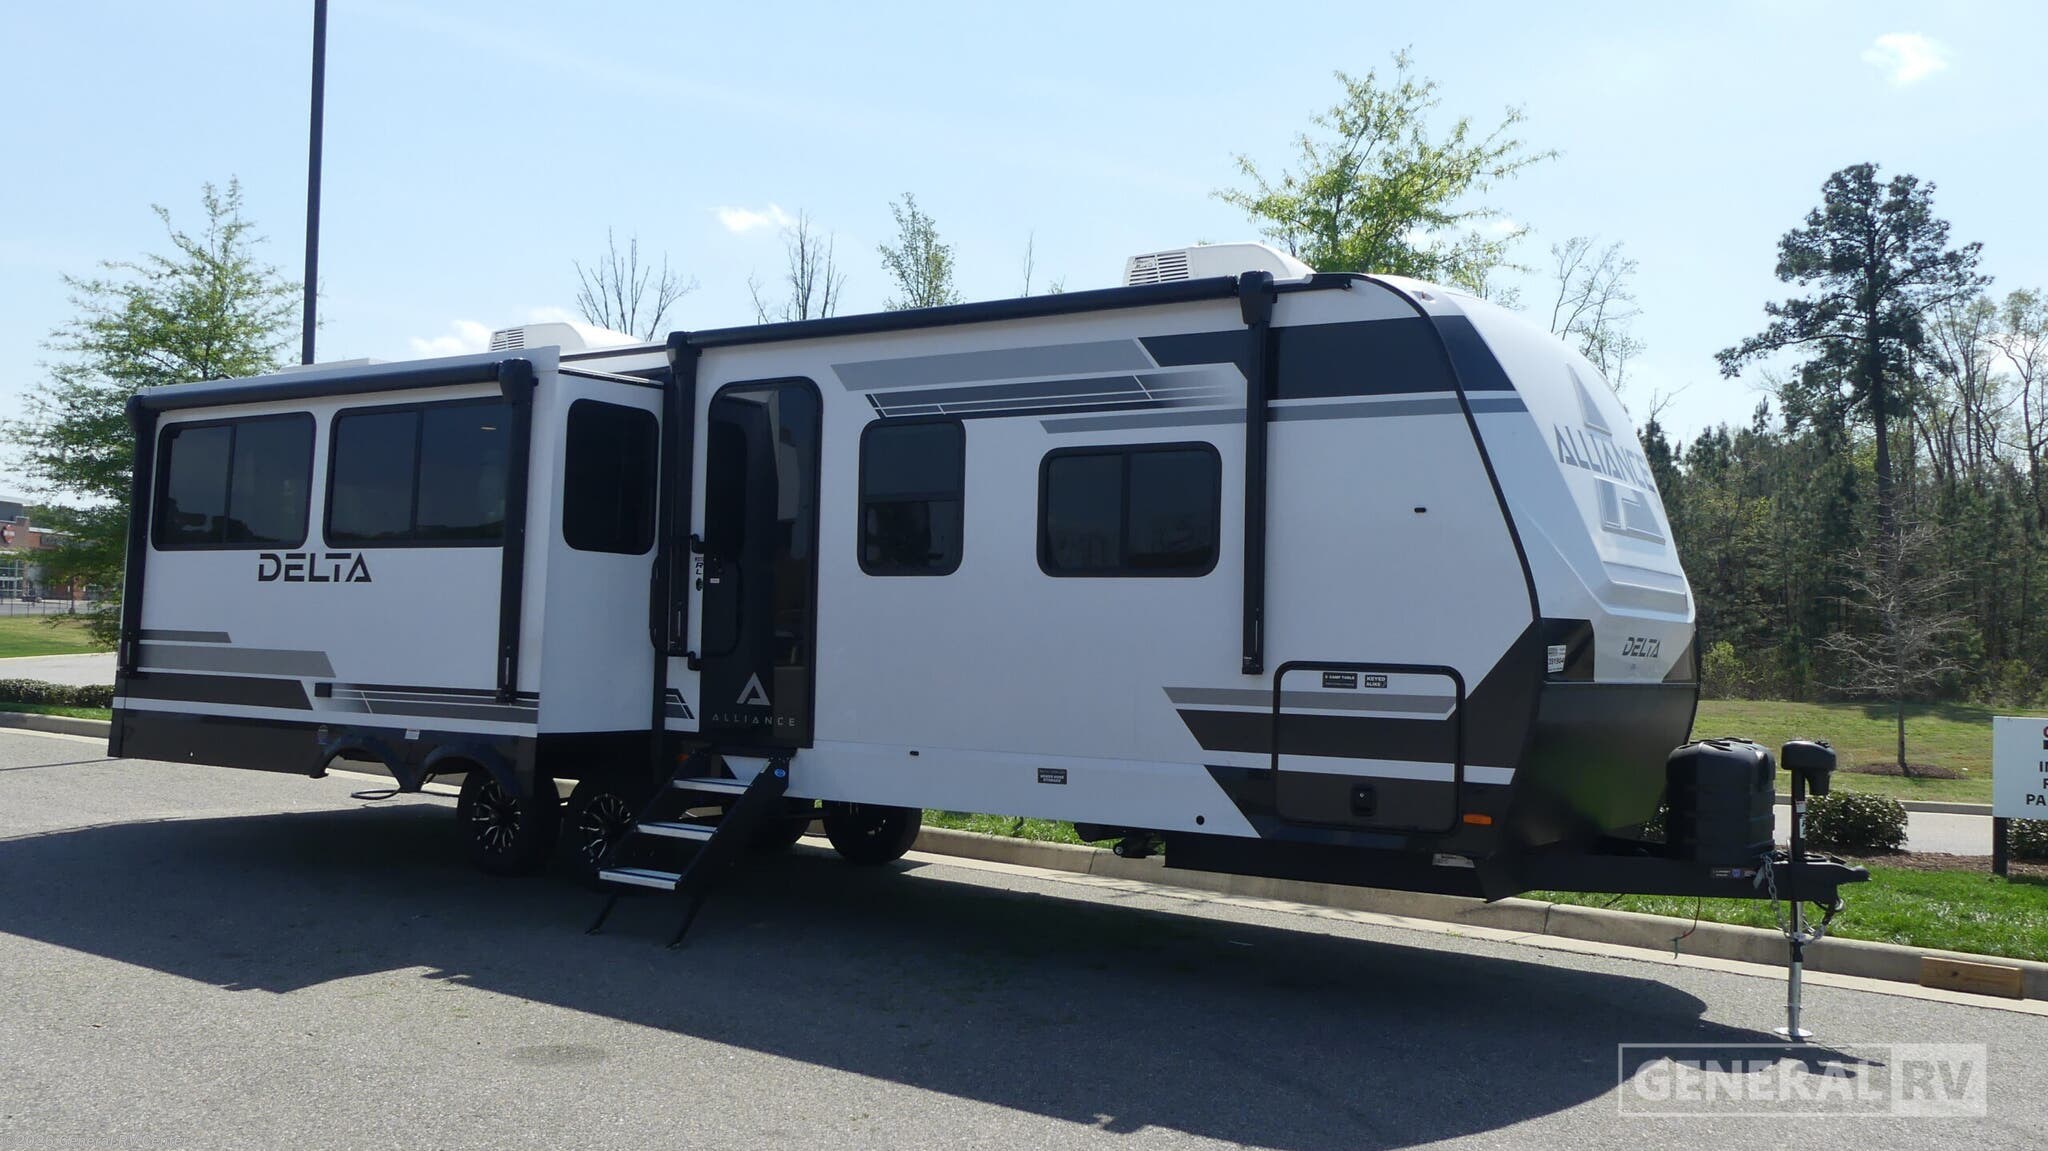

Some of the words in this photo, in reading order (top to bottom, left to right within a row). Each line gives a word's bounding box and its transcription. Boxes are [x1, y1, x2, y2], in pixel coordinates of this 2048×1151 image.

[1553, 422, 1657, 494] ALLIANCE
[258, 551, 372, 582] DELTA
[1622, 636, 1661, 658] DELTA
[712, 713, 796, 727] ALLIANCE
